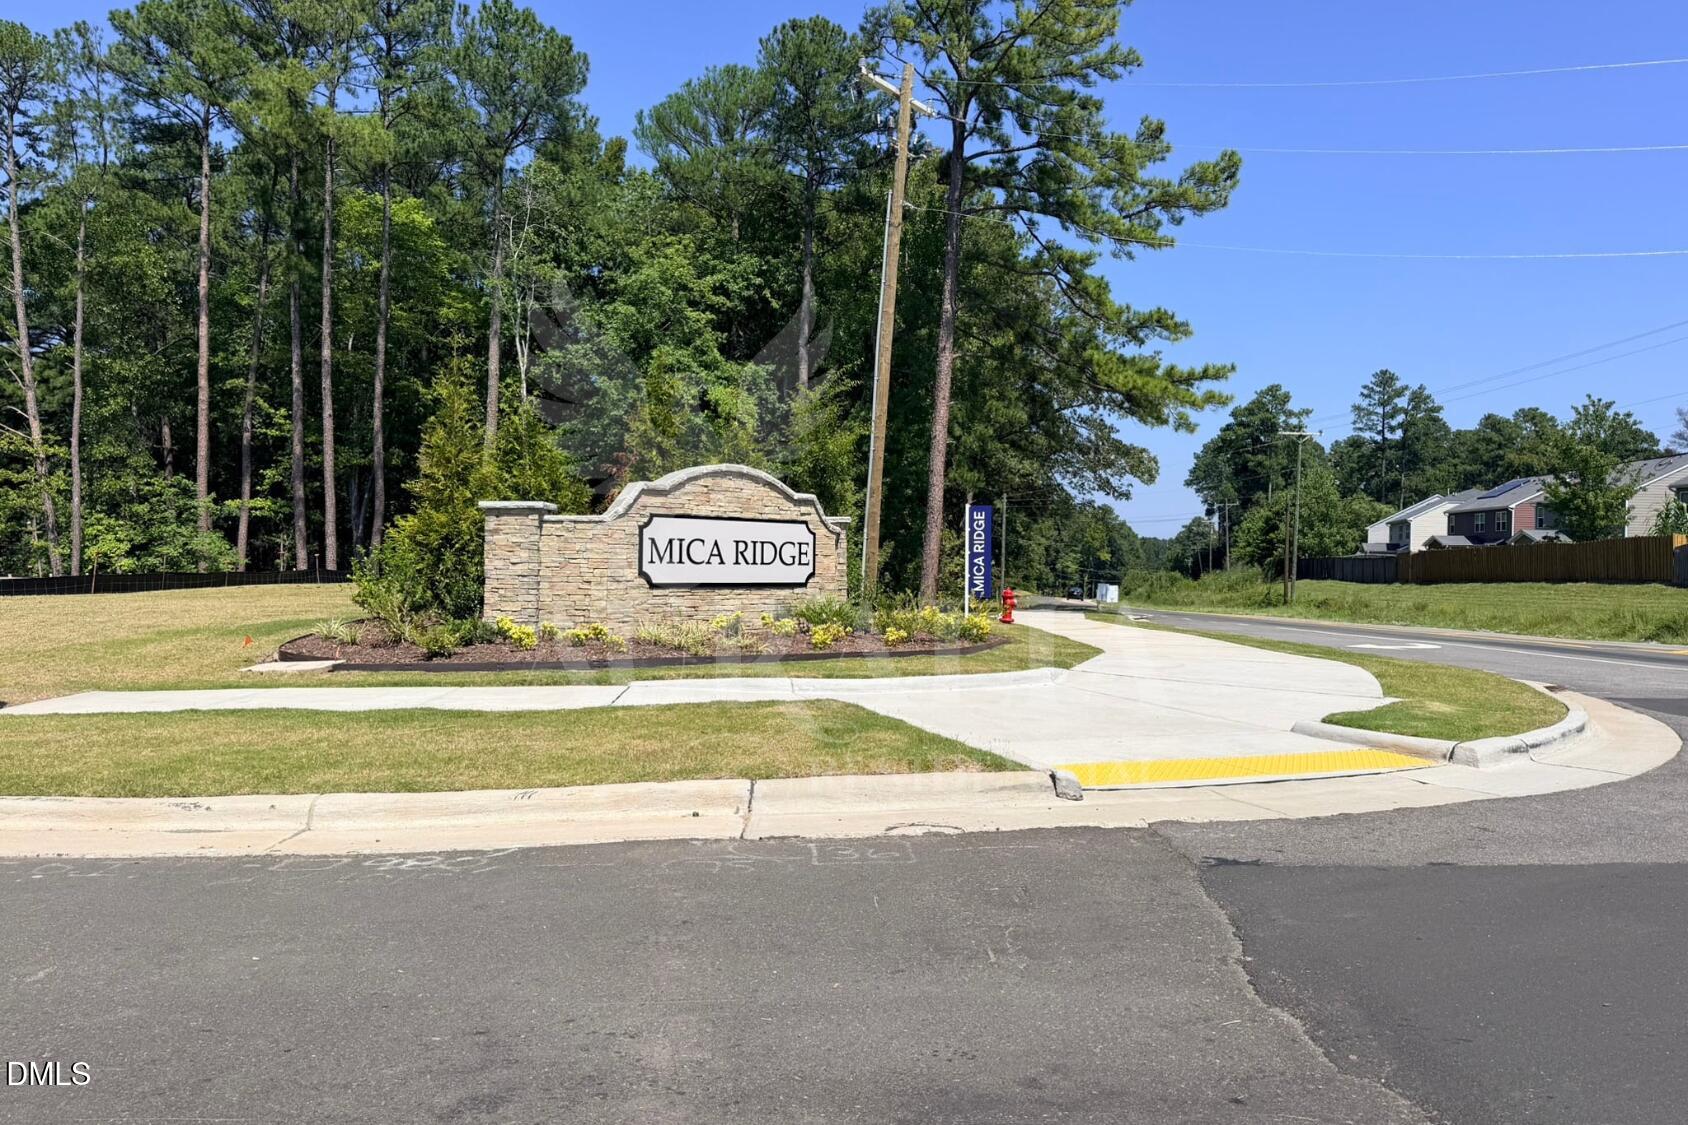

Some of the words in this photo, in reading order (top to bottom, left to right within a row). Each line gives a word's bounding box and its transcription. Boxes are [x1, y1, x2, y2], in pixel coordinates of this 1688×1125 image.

[973, 511, 985, 553] RIDGE
[648, 537, 726, 565] MICA
[733, 540, 810, 566] RIDGE
[973, 556, 985, 592] MICA
